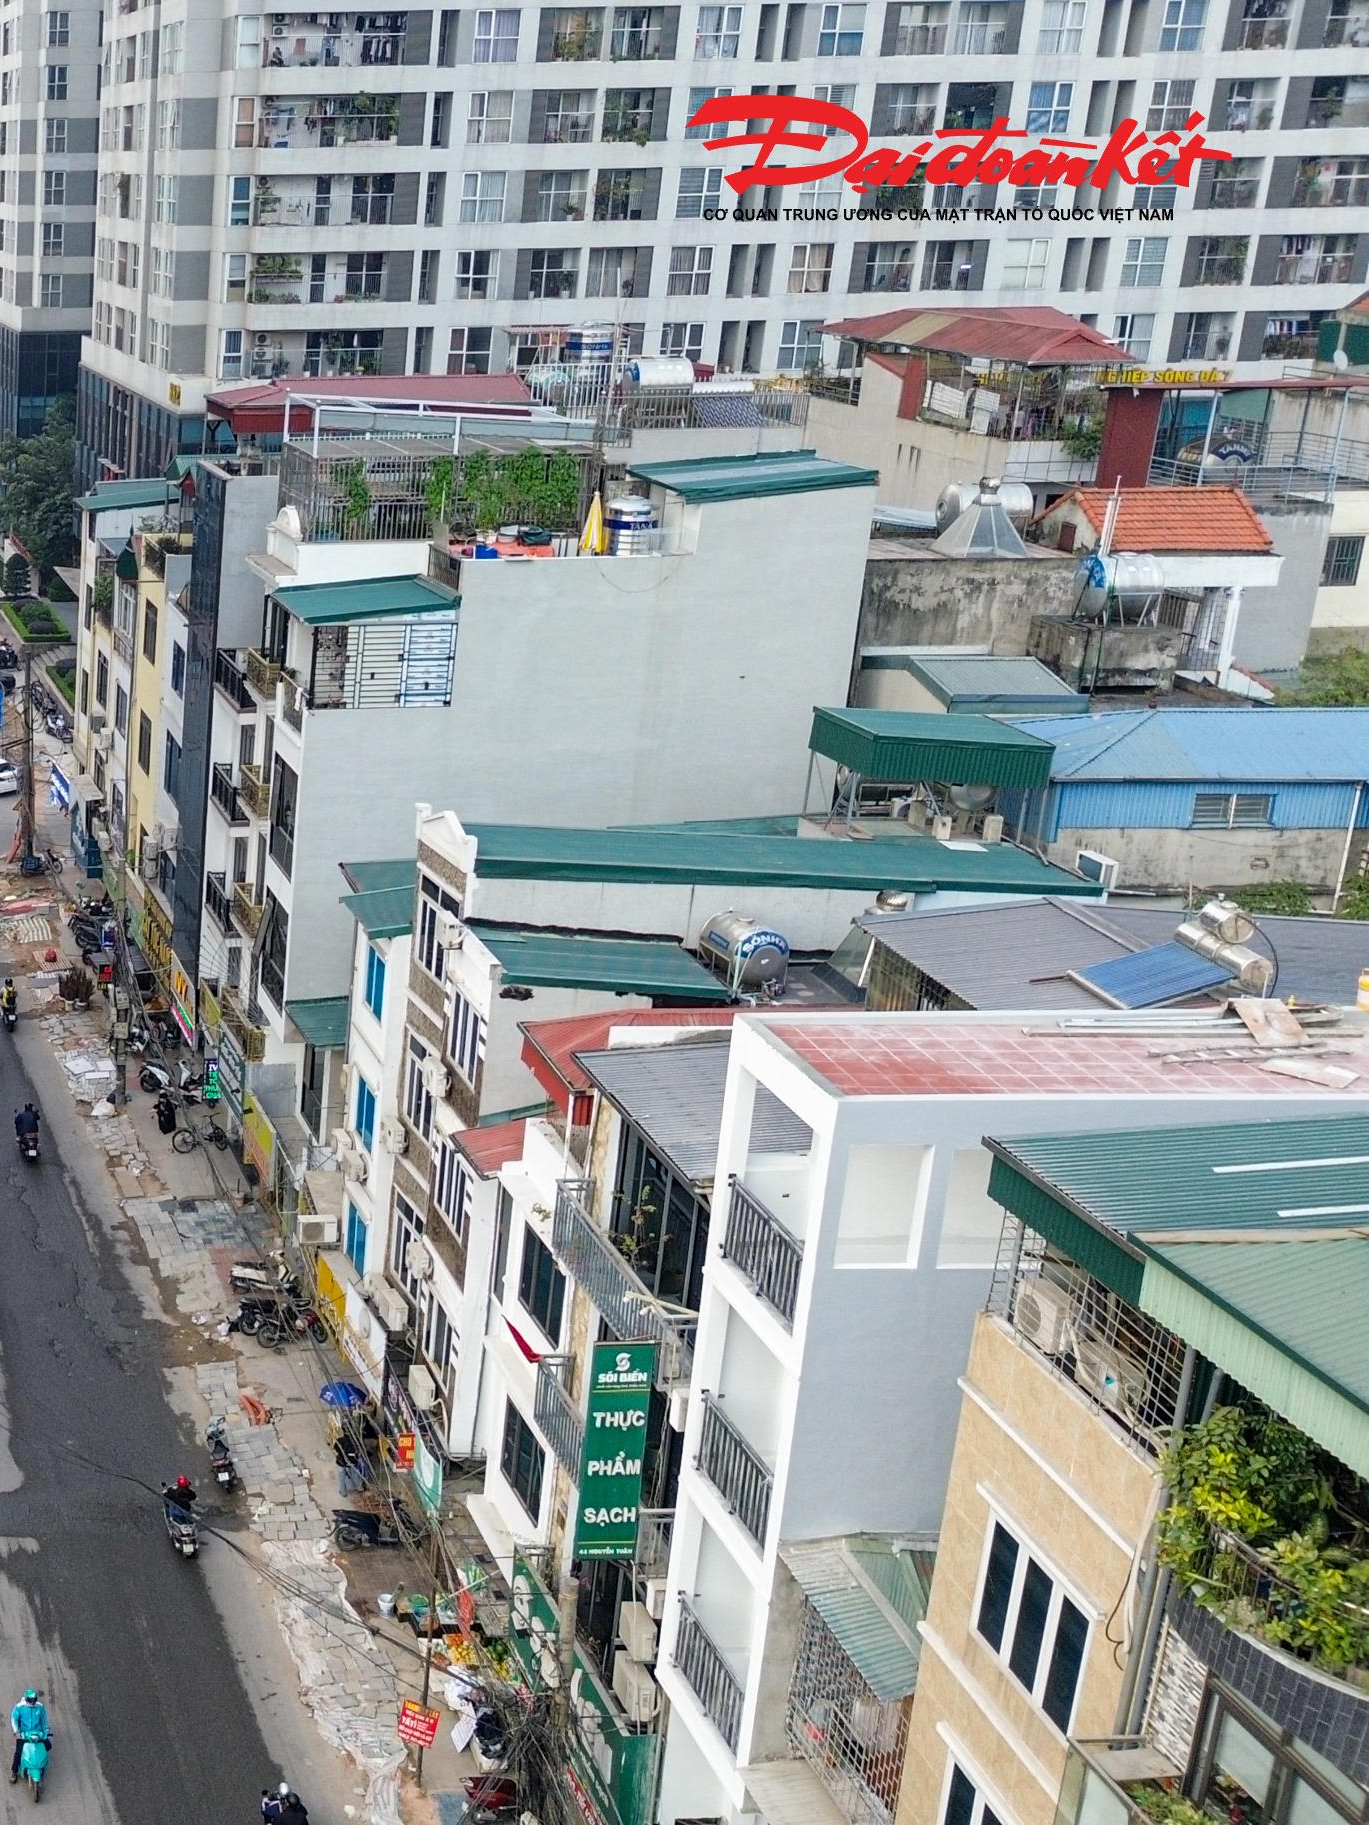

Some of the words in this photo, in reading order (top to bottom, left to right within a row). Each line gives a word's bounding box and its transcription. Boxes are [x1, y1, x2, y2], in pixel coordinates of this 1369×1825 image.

[593, 1409, 646, 1431] THỰC
[587, 1451, 641, 1476] PHẨM
[583, 1507, 637, 1527] SẠCH
